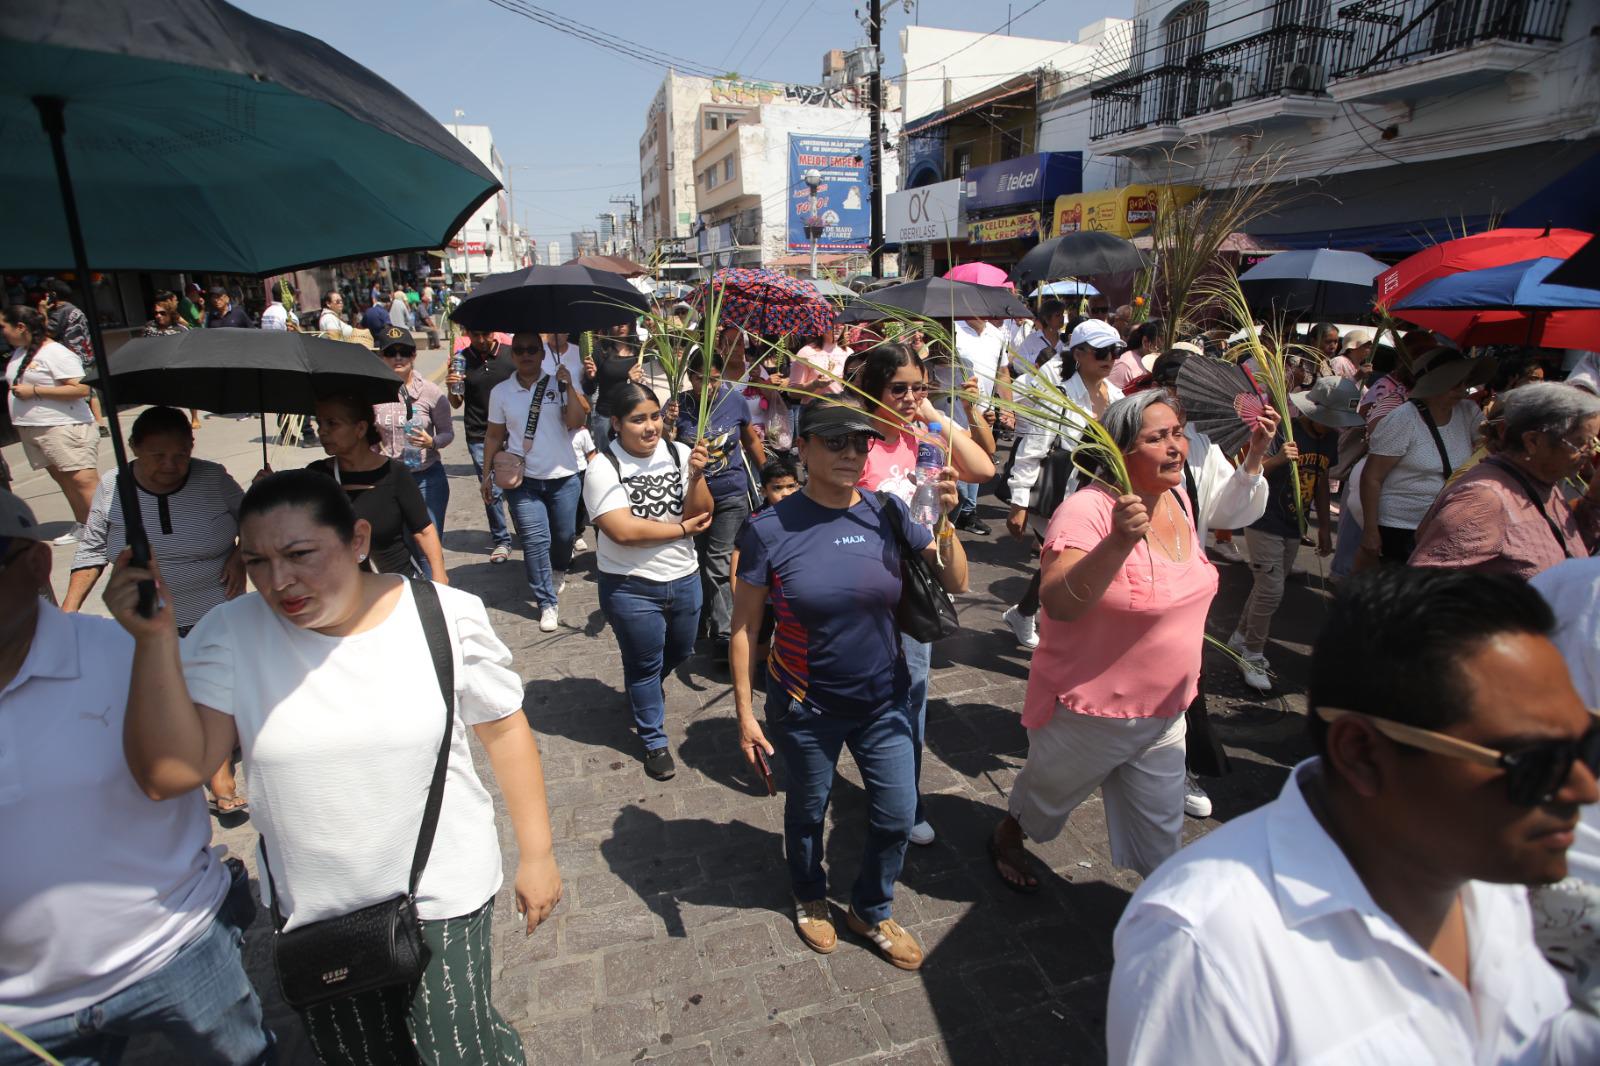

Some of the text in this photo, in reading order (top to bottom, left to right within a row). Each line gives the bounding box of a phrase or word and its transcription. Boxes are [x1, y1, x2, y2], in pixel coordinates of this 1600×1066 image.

[799, 154, 827, 167] MEJOR
[1006, 167, 1039, 191] telcel
[797, 197, 829, 214] TOO!
[985, 214, 1034, 231] CELULARES
[842, 534, 866, 544] MAJA
